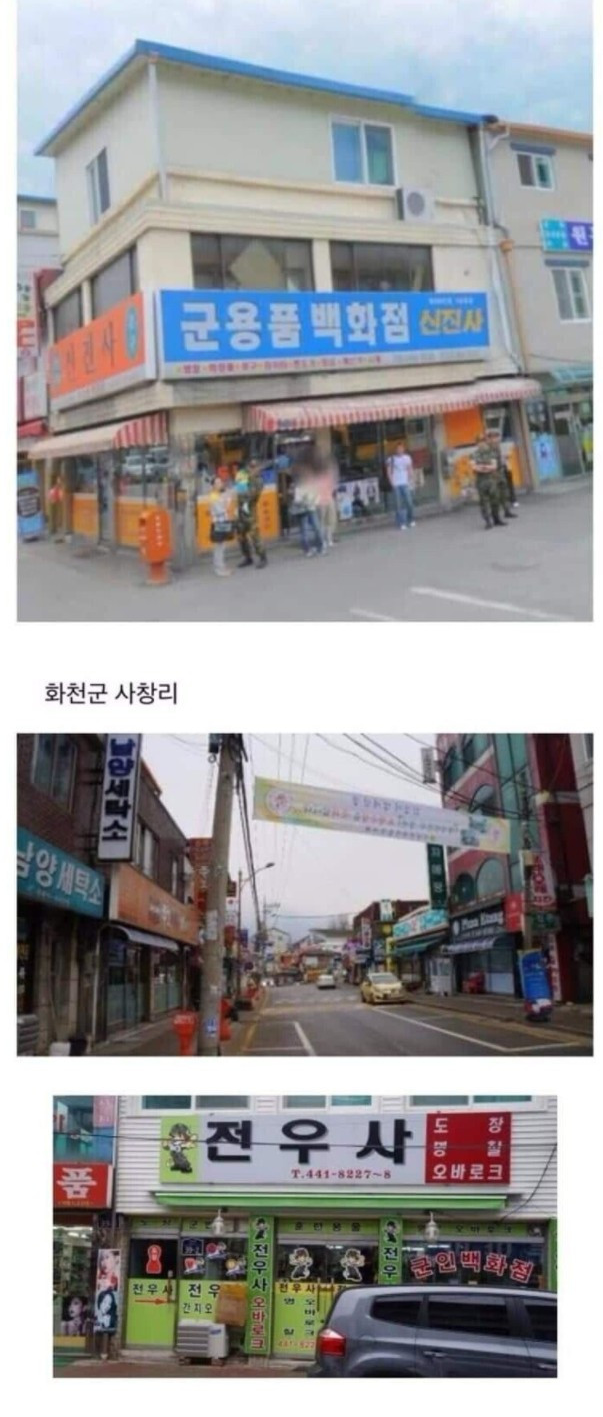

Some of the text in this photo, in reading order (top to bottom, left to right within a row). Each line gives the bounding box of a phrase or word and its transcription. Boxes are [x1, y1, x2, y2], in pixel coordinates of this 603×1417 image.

[180, 301, 410, 351] 군용품 백화점
[102, 738, 136, 842] 남양세탁소
[17, 842, 101, 906] 남양세탁소
[206, 1118, 413, 1166] 전우사
[291, 1169, 392, 1180] T.441-8227~8
[432, 1163, 503, 1180] 오바로크
[252, 1244, 268, 1292] 전우사
[411, 1250, 534, 1284] 군인백화점
[251, 1297, 266, 1349] 오바로크
